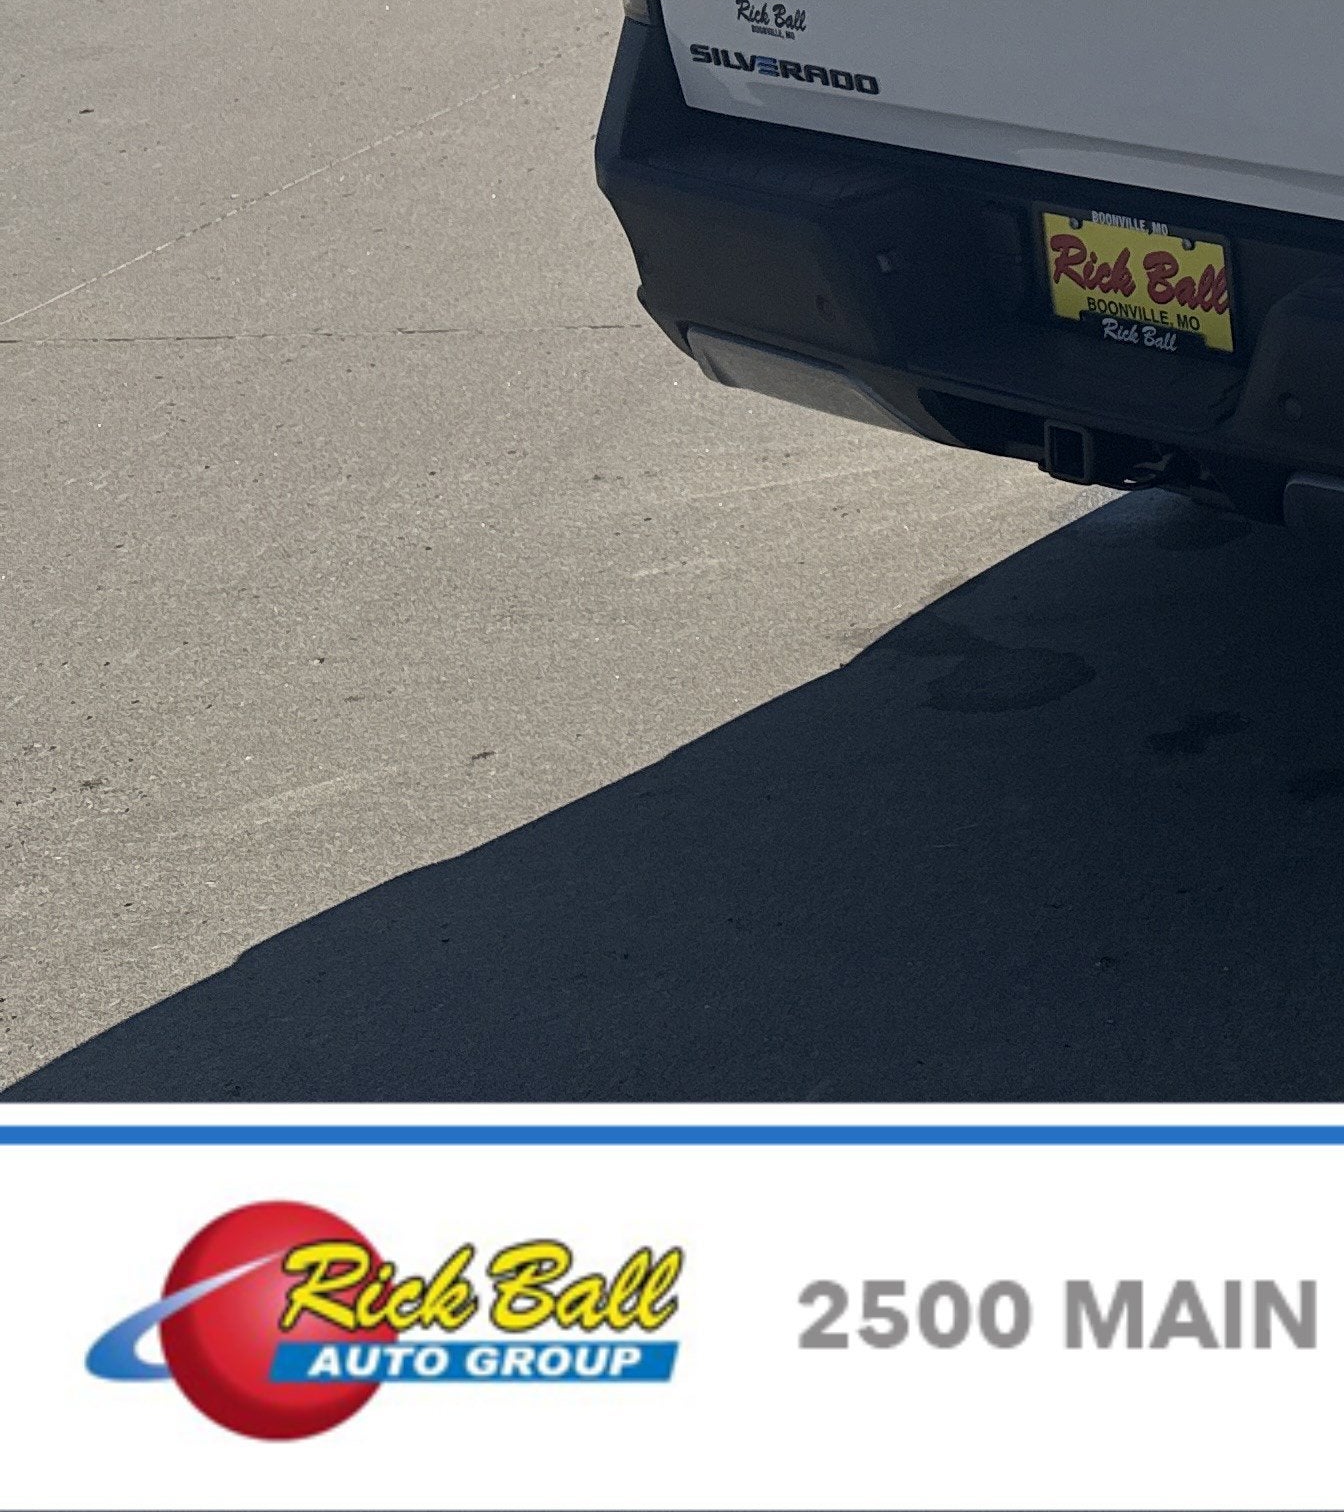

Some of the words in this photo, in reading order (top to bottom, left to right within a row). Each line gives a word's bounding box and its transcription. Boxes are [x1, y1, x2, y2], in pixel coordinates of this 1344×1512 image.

[772, 3, 807, 32] Ball
[689, 43, 880, 95] SILVERADO
[1091, 210, 1150, 234] BOONVILLE,
[1151, 221, 1169, 236] MO
[1050, 234, 1136, 298] Rick
[1143, 251, 1229, 315] Ball
[1087, 296, 1174, 328] BOONVILLE,
[1176, 313, 1201, 331] MO
[1101, 317, 1140, 344] Rick
[1141, 326, 1178, 352] Ball
